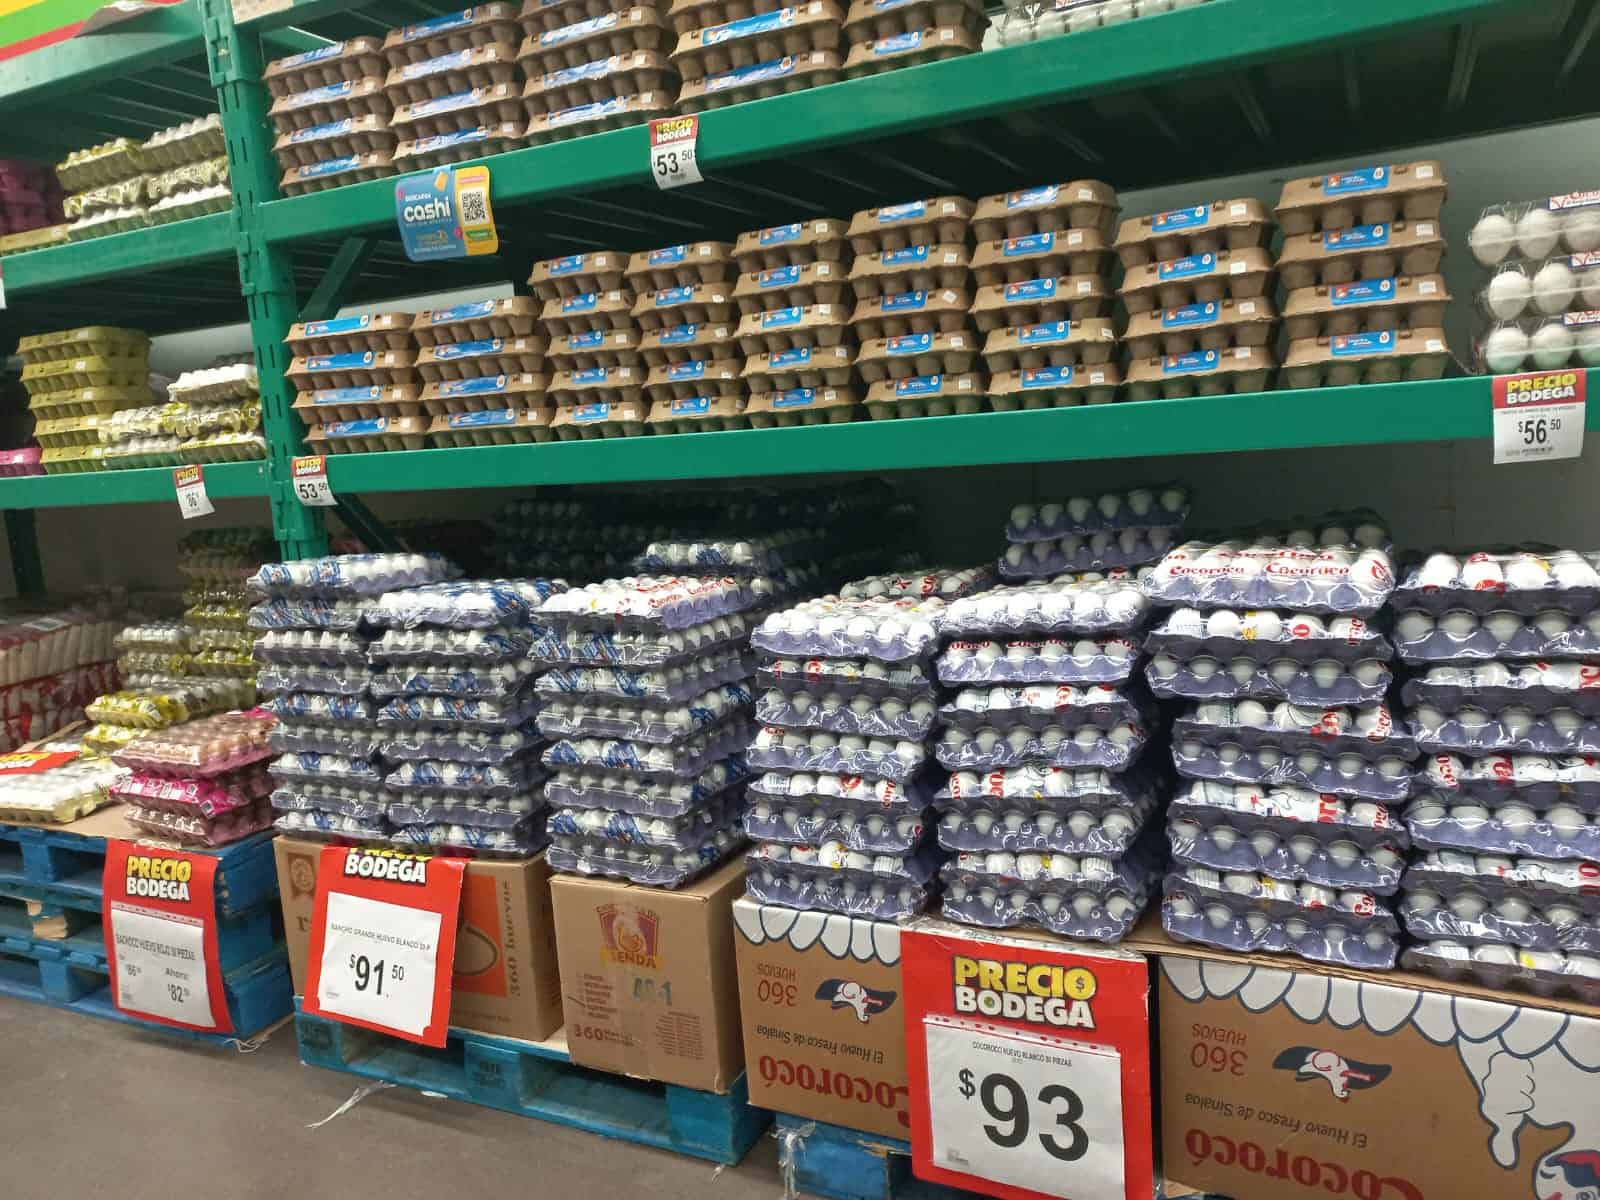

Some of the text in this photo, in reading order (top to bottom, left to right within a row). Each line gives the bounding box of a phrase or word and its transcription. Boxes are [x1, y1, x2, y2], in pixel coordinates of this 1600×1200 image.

[404, 196, 451, 222] cashi
[1507, 373, 1577, 393] PRECIO
[1507, 386, 1575, 404] BODEGA
[127, 855, 192, 882] PRECIO
[344, 853, 426, 884] BODEGA
[126, 877, 190, 901] BODEGA
[391, 964, 405, 981] 50
[757, 962, 796, 980] HUEVOS
[954, 956, 1096, 1000] PRECIO
[758, 979, 799, 1007] 360
[955, 986, 1095, 1029] BODEGA
[756, 1024, 884, 1064] El Huevo Fresco de Sinaloa
[1191, 1023, 1248, 1045] HUEVOS
[1190, 1041, 1248, 1077] 360
[1185, 1092, 1368, 1149] El Huevo Fresco de Sinaloa
